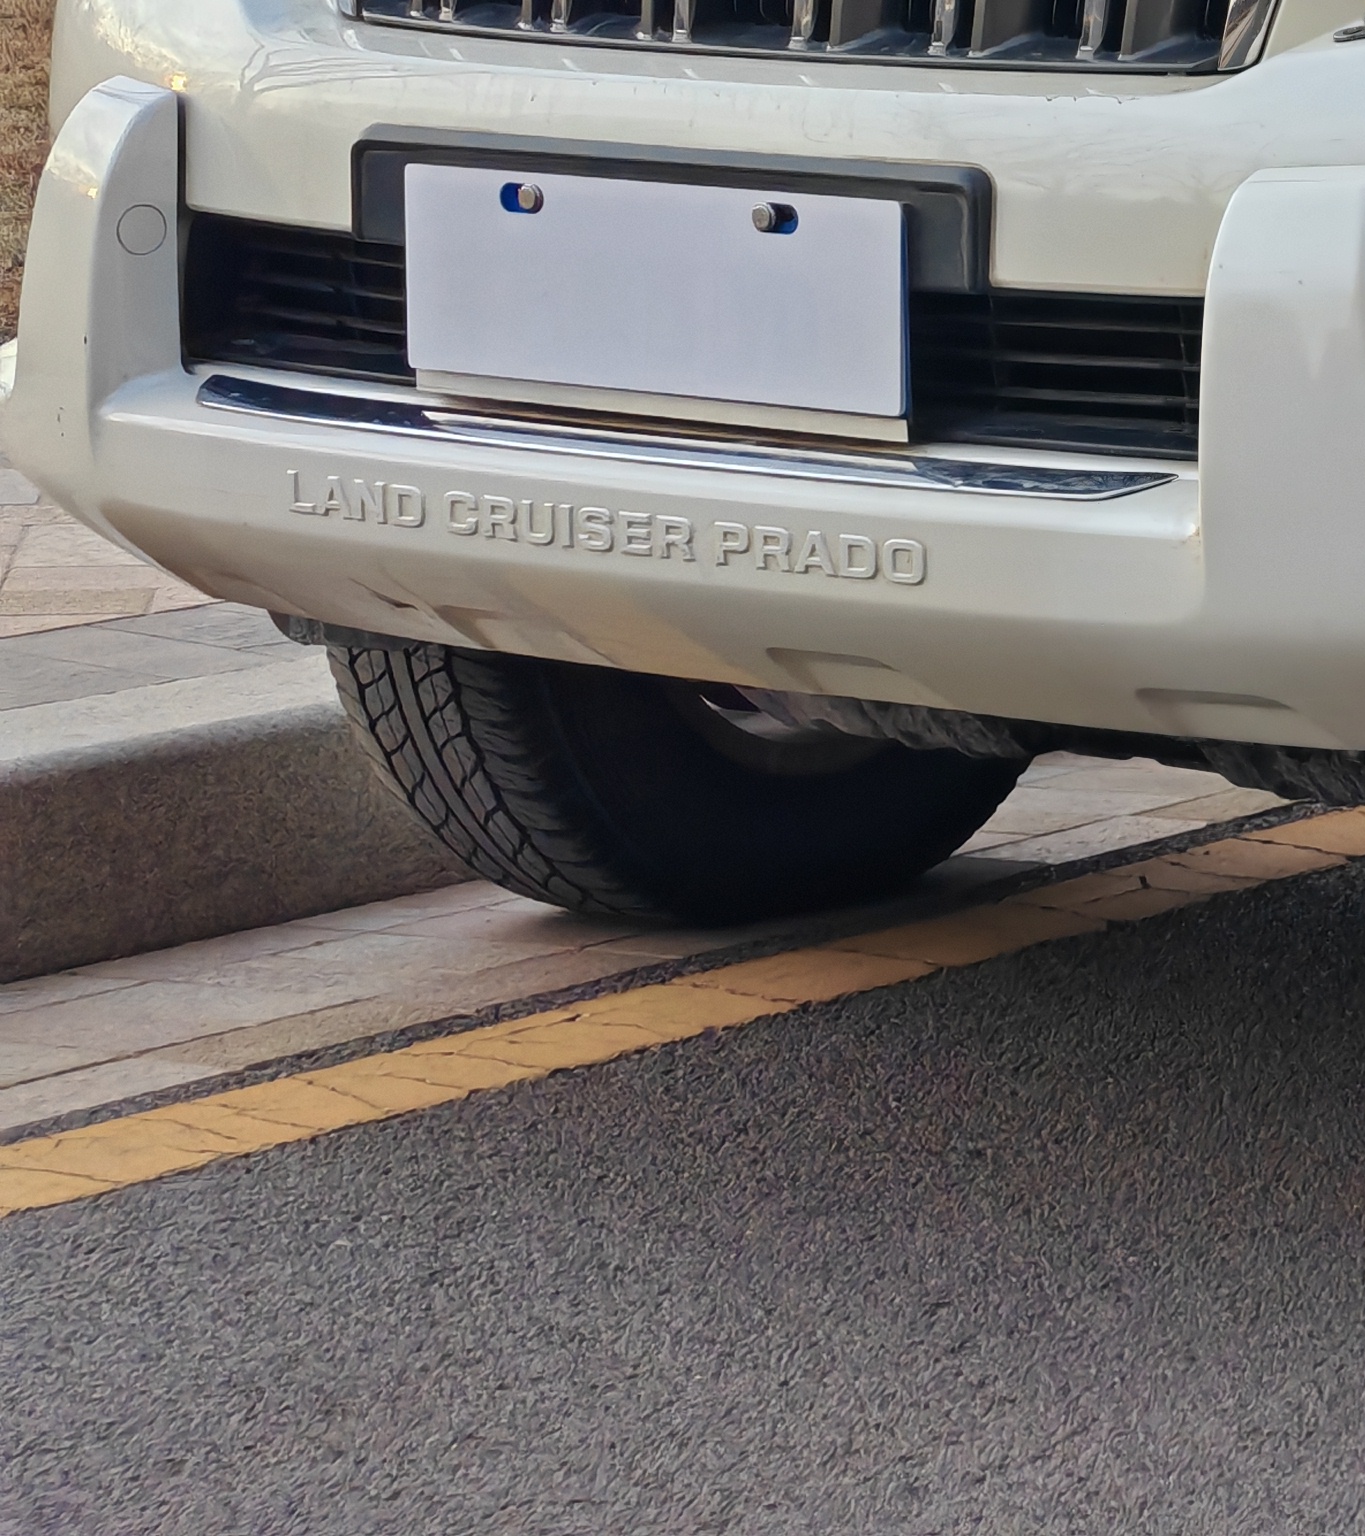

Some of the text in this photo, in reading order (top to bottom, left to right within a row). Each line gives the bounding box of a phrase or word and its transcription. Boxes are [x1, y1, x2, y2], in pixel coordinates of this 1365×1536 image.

[286, 468, 928, 586] LAND CRUISER PRADO
